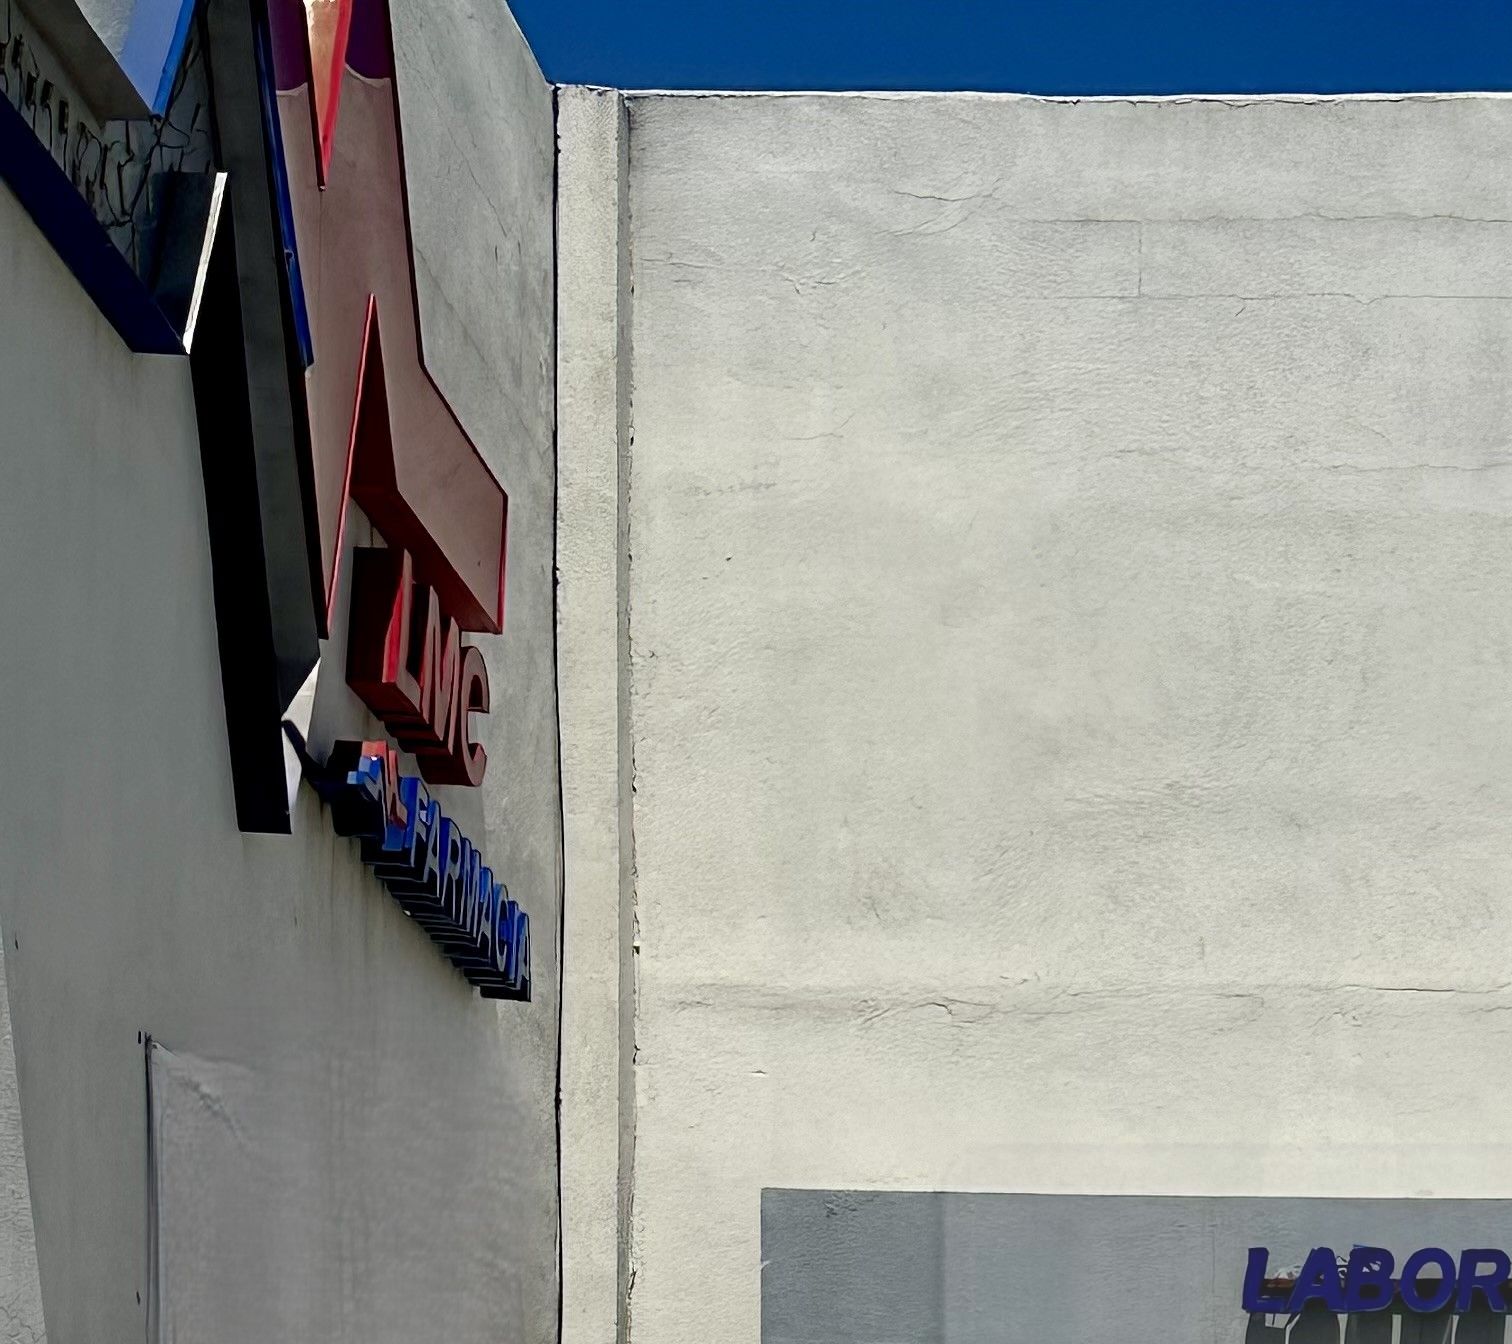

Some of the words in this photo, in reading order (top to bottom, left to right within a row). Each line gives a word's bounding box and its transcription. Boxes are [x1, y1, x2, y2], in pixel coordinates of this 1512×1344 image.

[380, 546, 490, 787] LMC
[400, 776, 532, 1002] FARMACIA
[1241, 1245, 1512, 1314] LABOR
